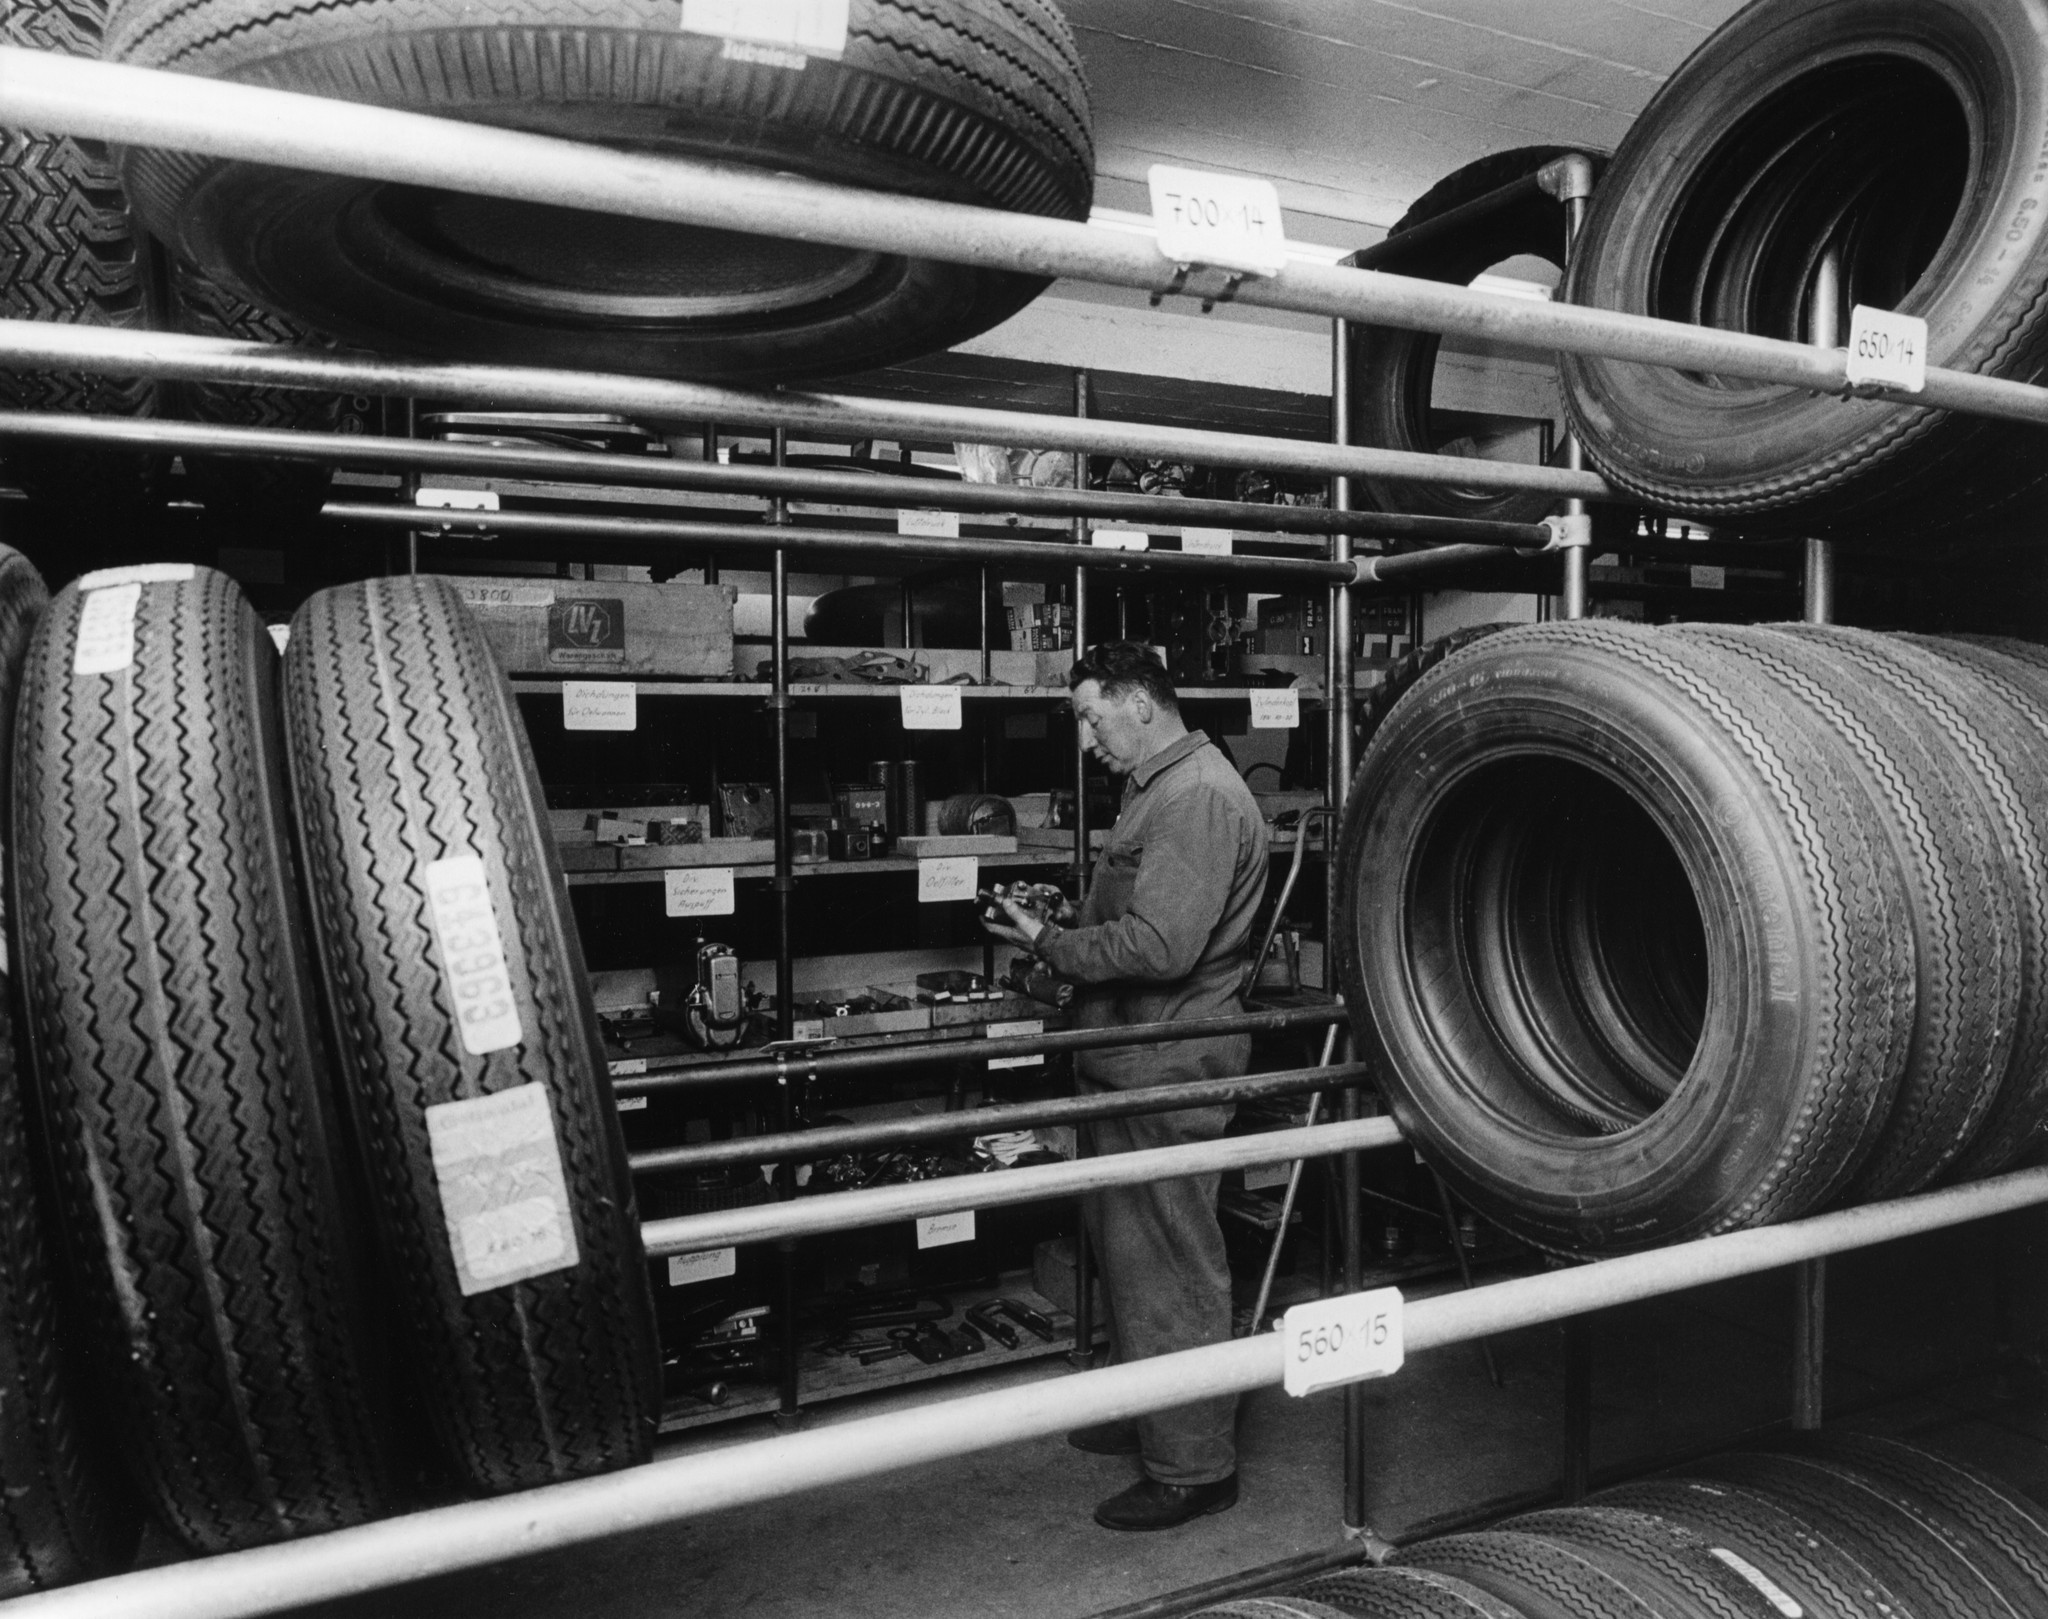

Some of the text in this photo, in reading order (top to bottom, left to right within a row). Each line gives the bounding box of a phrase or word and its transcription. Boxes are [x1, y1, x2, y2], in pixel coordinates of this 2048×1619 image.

[1165, 193, 1219, 227] 700
[1240, 203, 1265, 236] 14
[1858, 330, 1914, 365] 650 14
[437, 884, 509, 1023] 643963
[1298, 1313, 1388, 1363] 560 15
